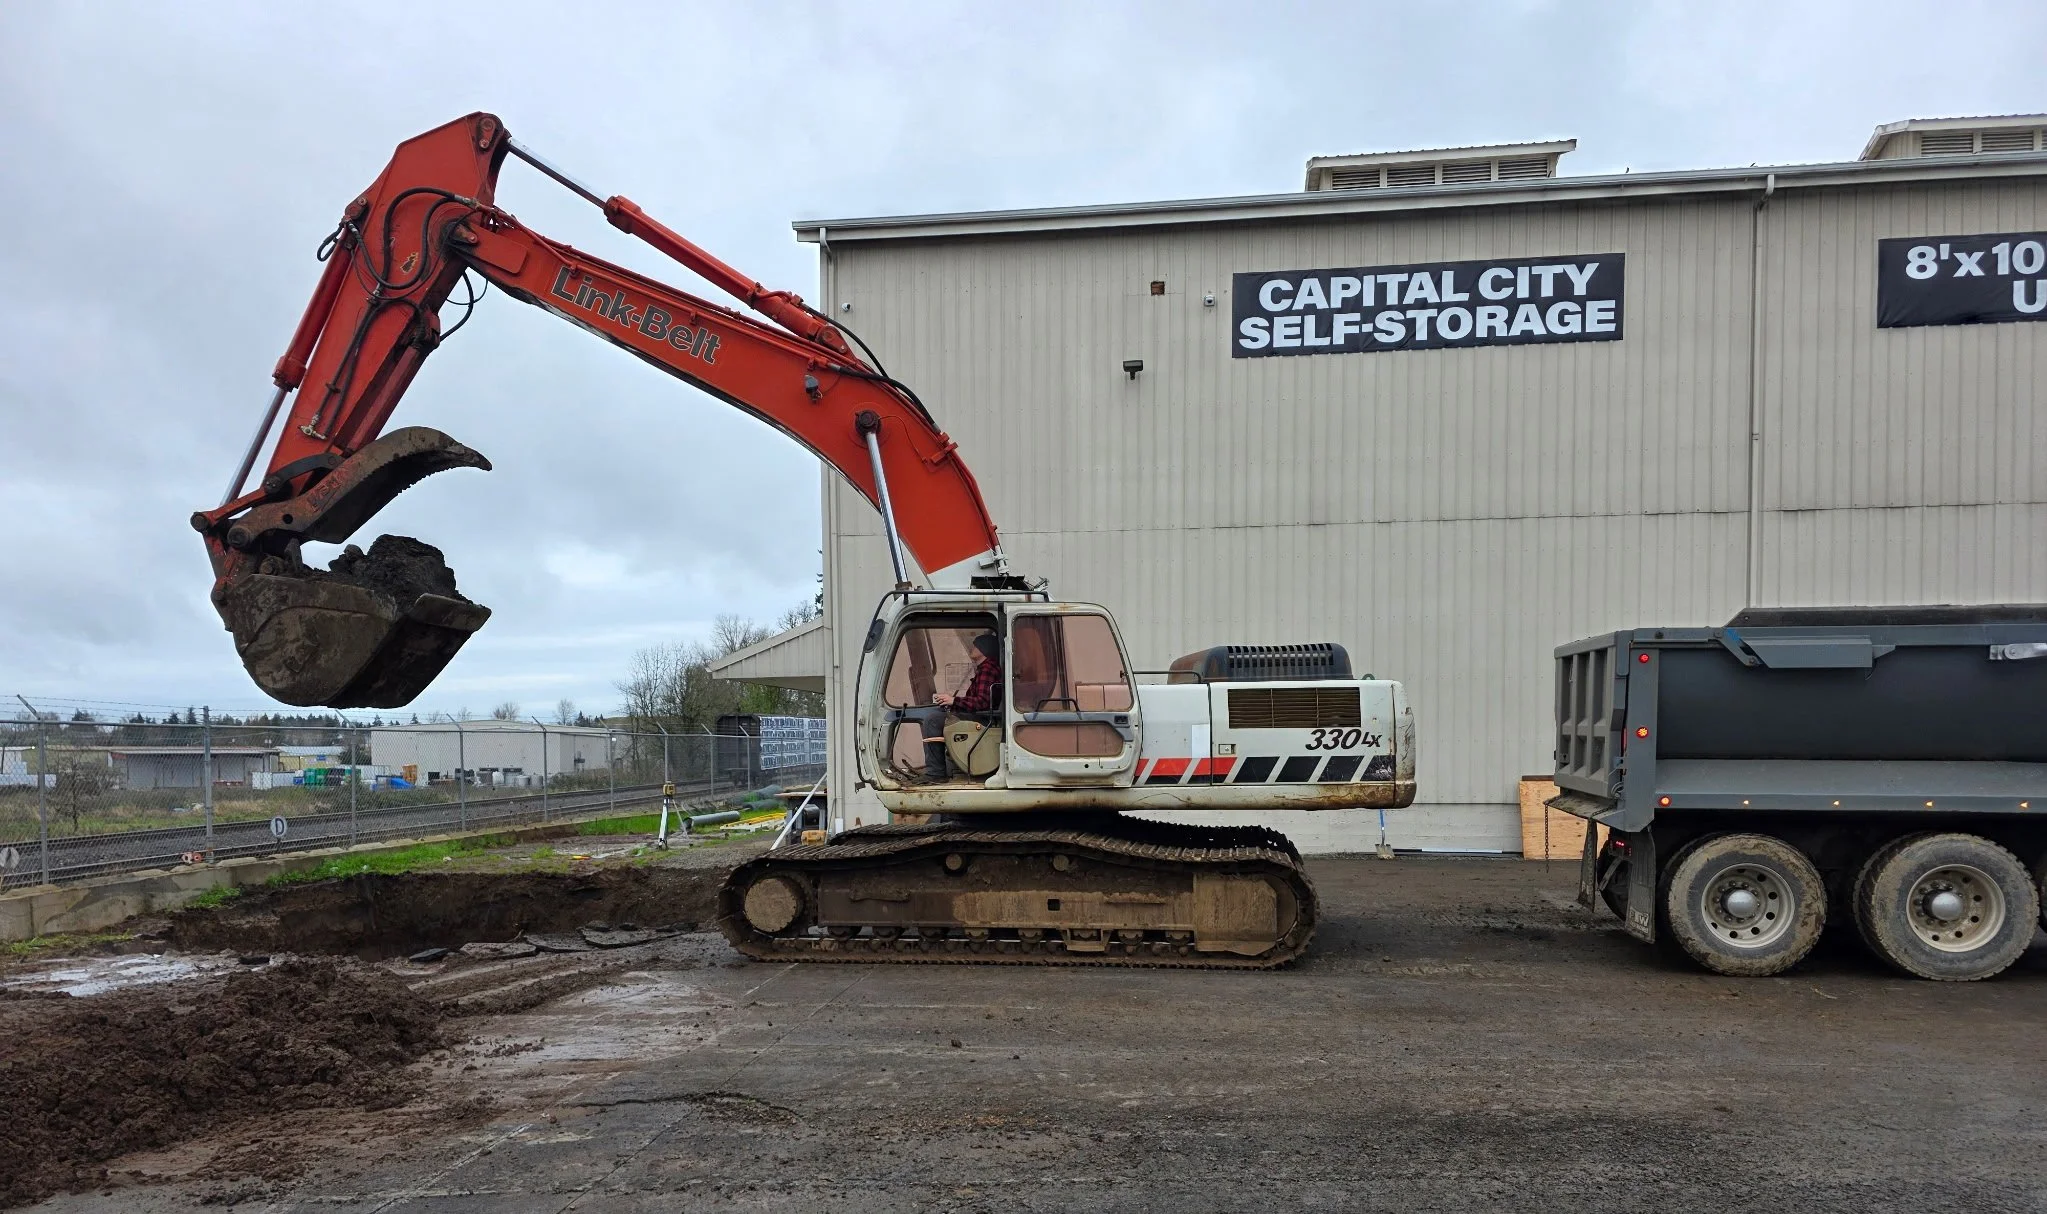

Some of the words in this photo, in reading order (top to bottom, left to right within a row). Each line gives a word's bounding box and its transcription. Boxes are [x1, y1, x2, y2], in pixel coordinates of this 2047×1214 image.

[1258, 270, 1470, 312] CAPITAL
[1478, 262, 1600, 300] CITY
[551, 266, 721, 365] Link-Belt
[1238, 300, 1616, 349] SELF-STORAGE
[275, 817, 285, 836] D
